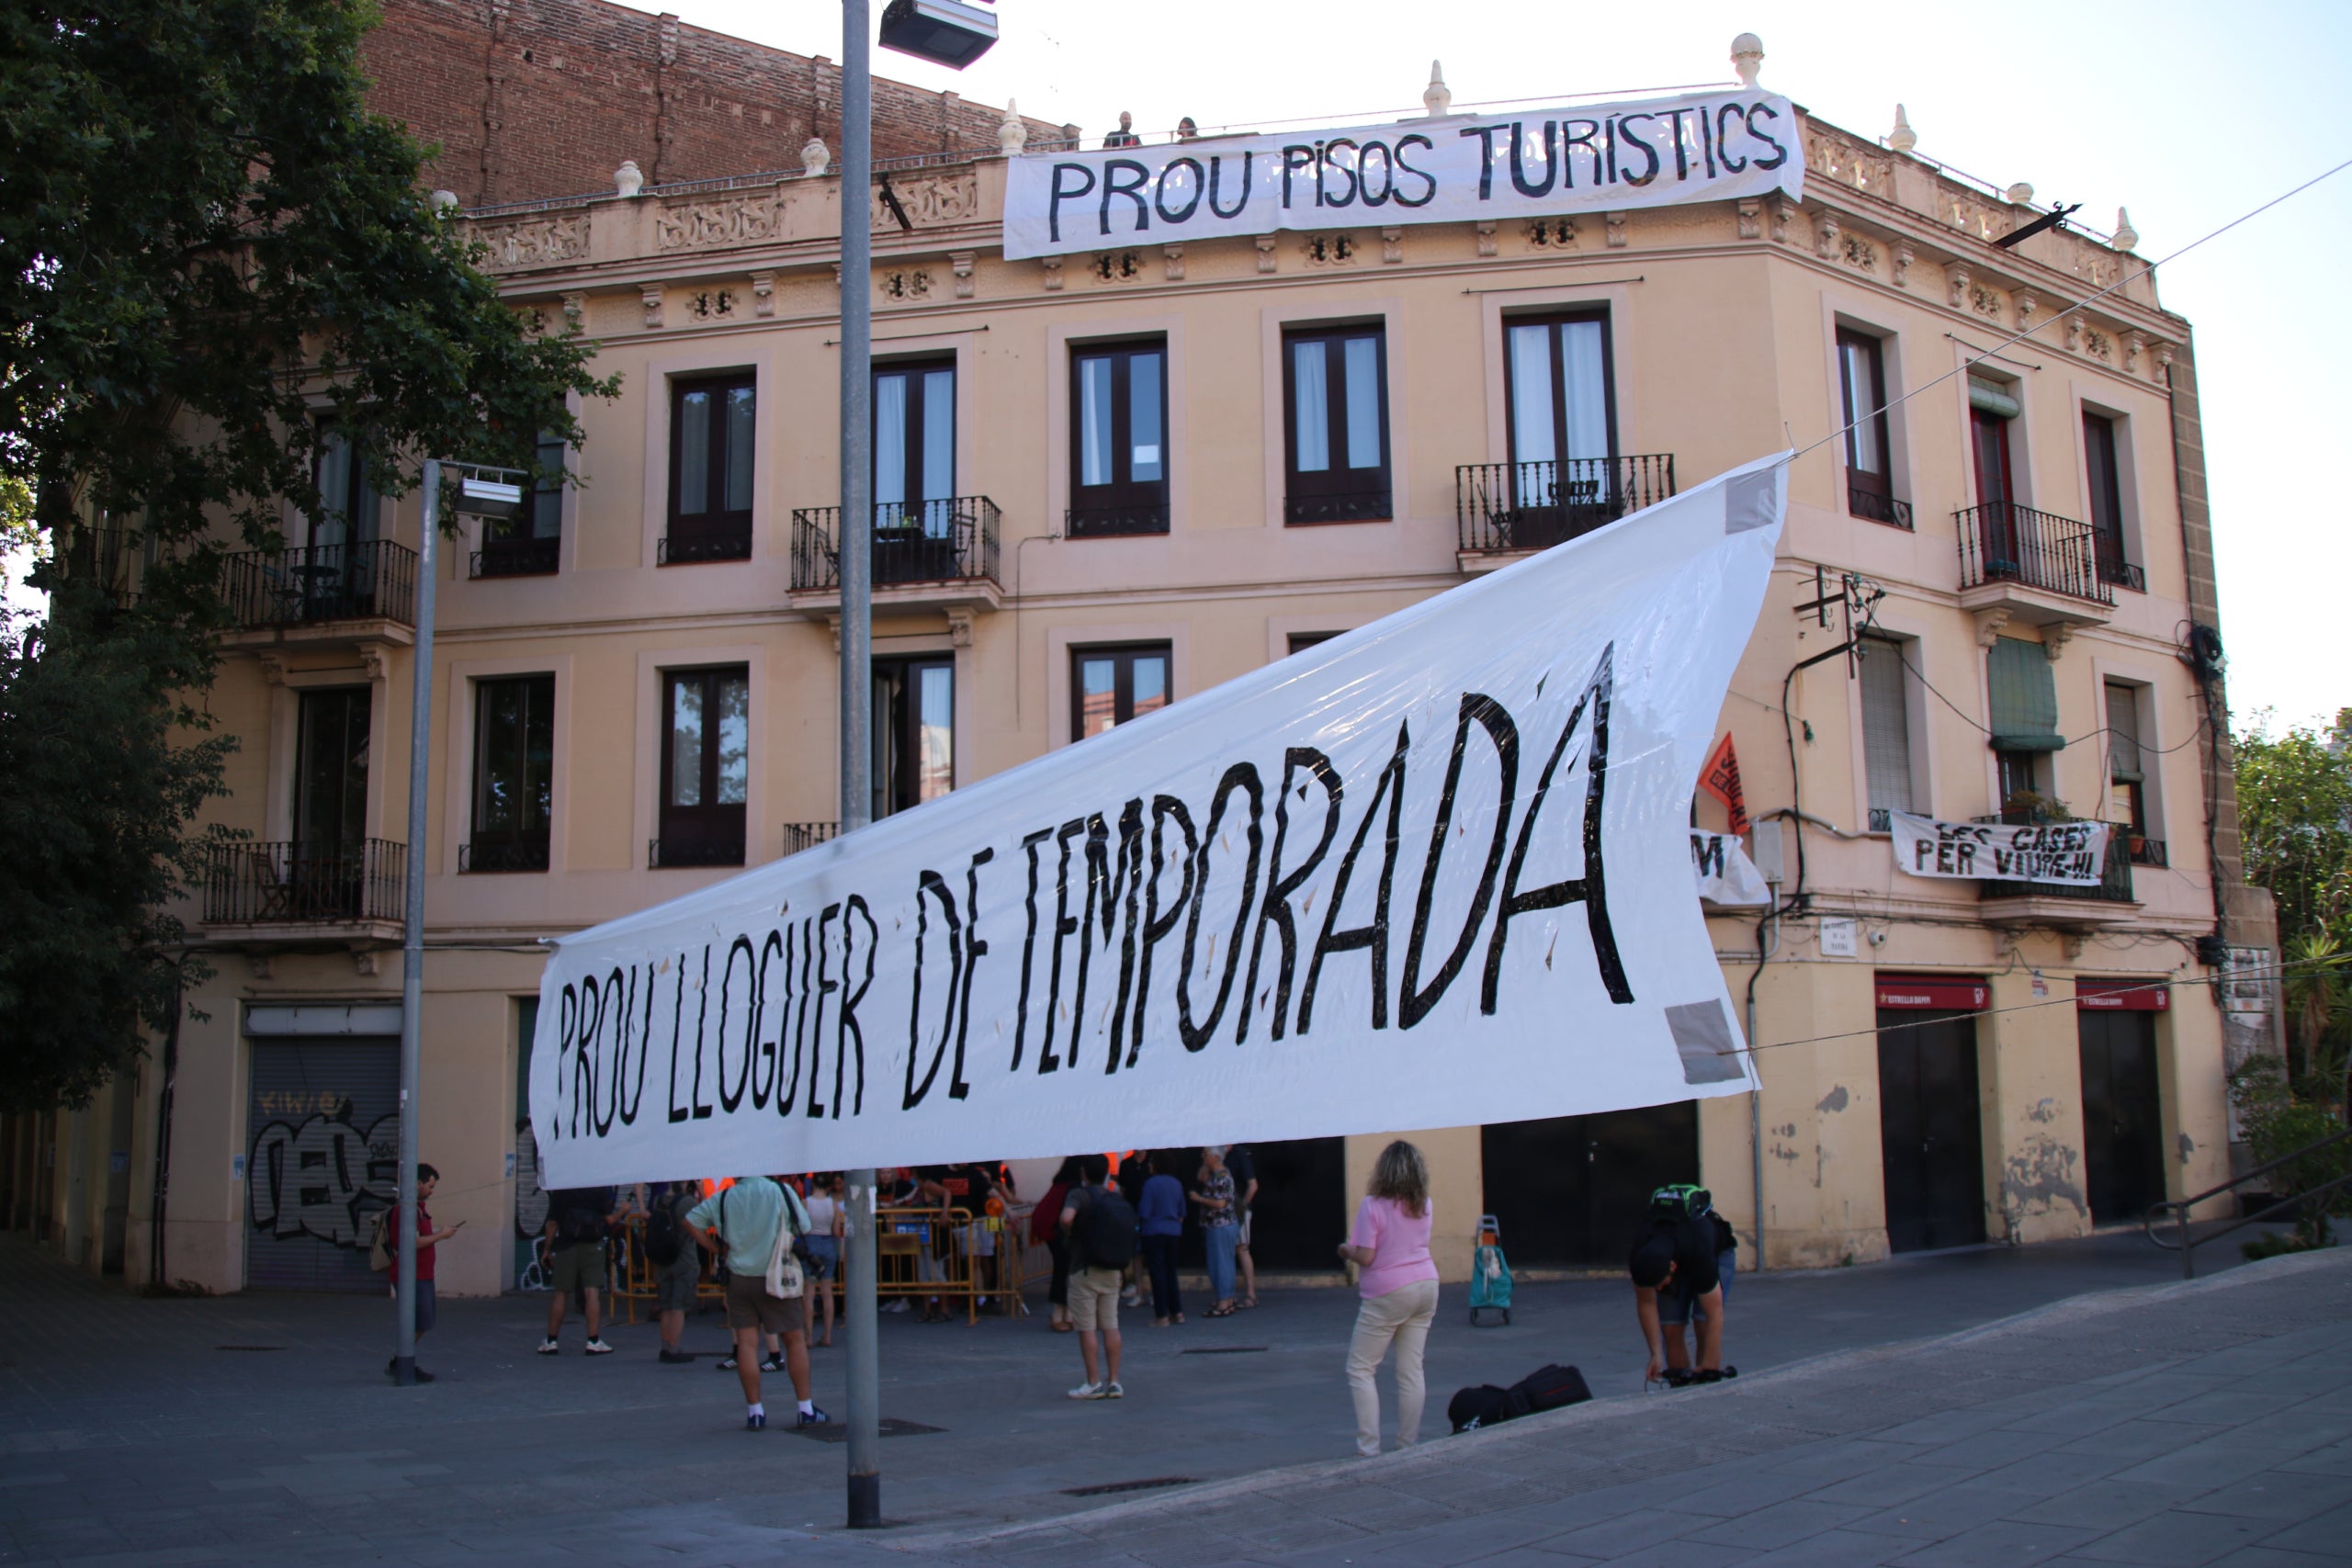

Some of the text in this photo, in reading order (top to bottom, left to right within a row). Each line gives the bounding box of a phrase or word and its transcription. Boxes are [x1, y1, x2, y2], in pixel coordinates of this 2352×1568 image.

[1050, 151, 1252, 243] PROU
[2012, 824, 2091, 852] CASES
[1916, 840, 1976, 874] PER
[554, 640, 1635, 1140] PROU LLOGUER DE TEMPORADA
[1888, 996, 1931, 1005] ESTRELLA DAMM
